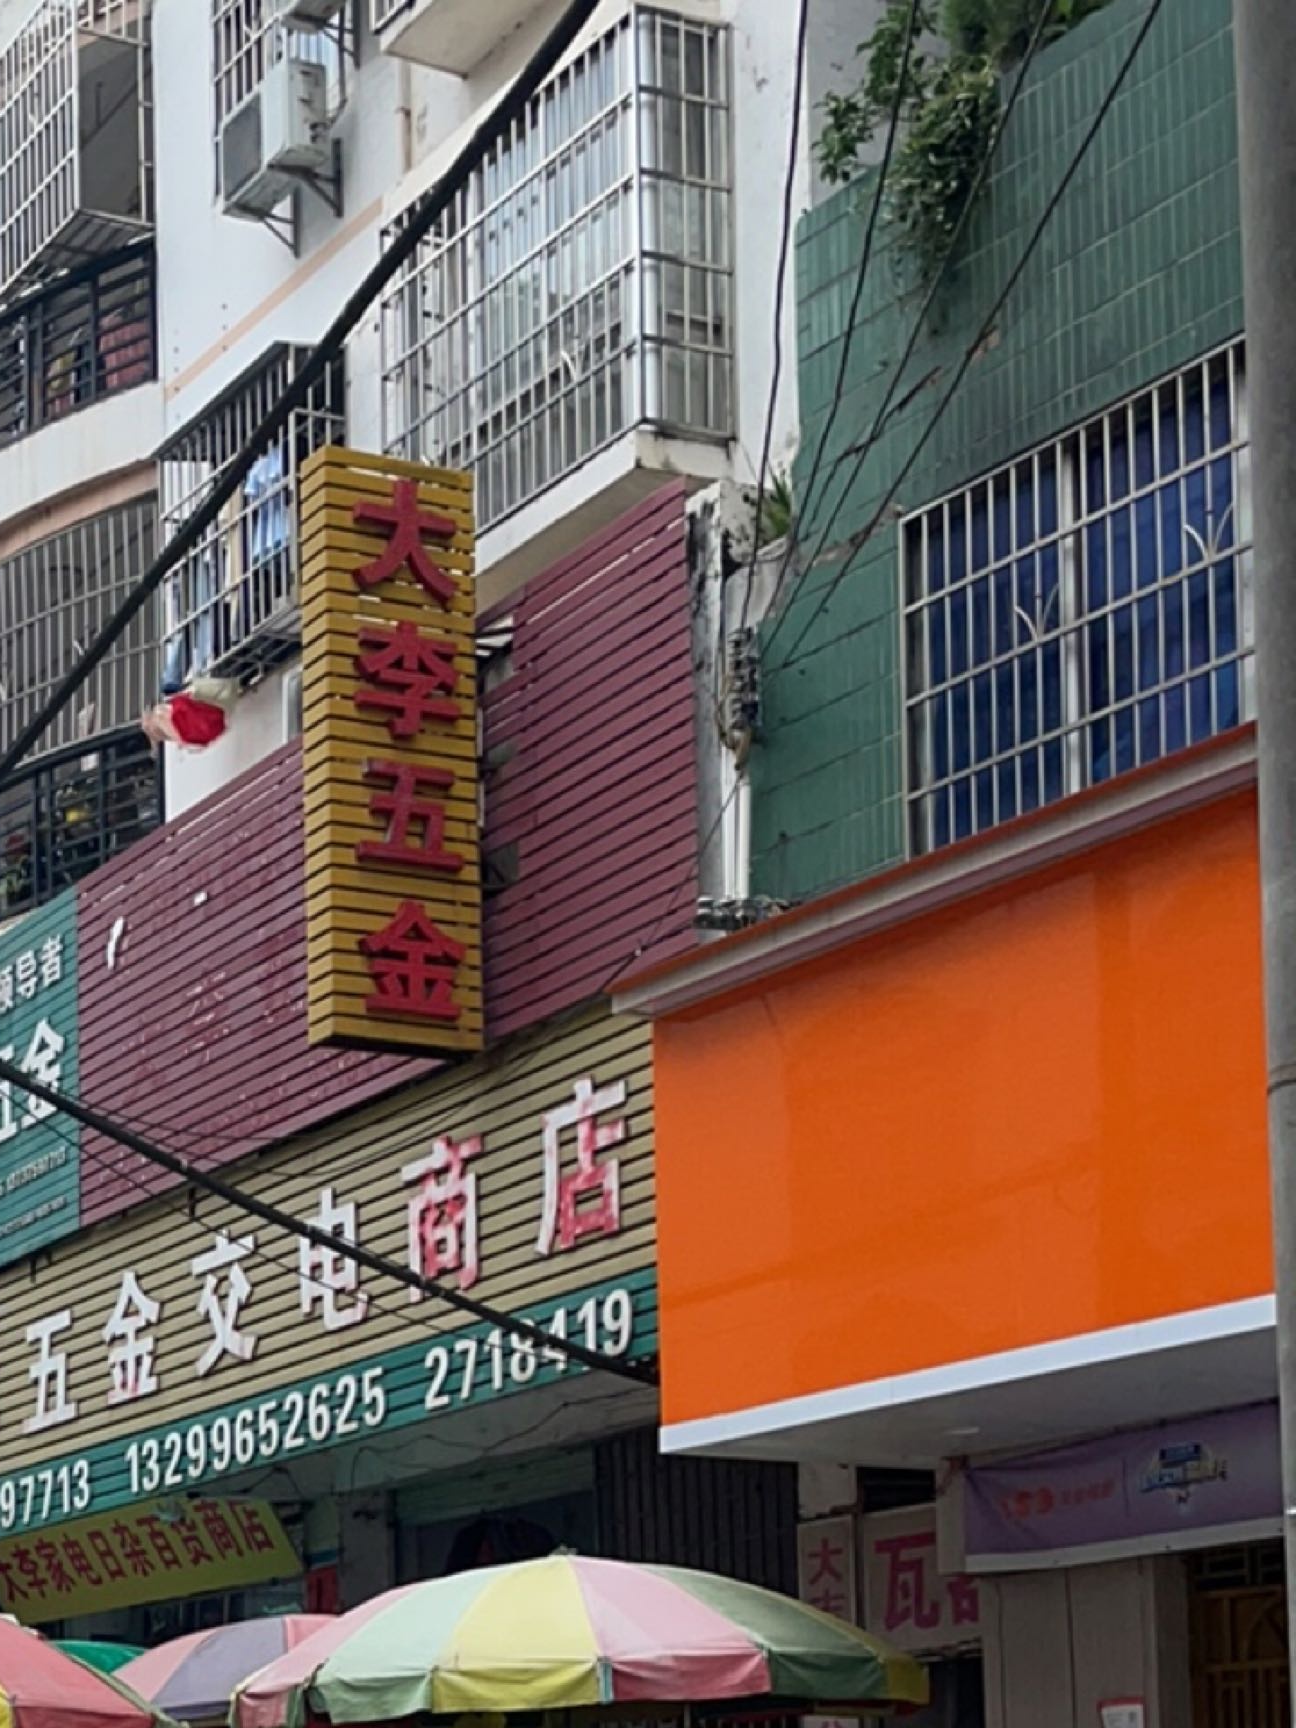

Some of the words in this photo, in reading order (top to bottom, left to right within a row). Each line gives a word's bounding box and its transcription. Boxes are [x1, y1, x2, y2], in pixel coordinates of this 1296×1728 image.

[352, 477, 467, 1019] 大李五金
[124, 1365, 387, 1494] 13299652625
